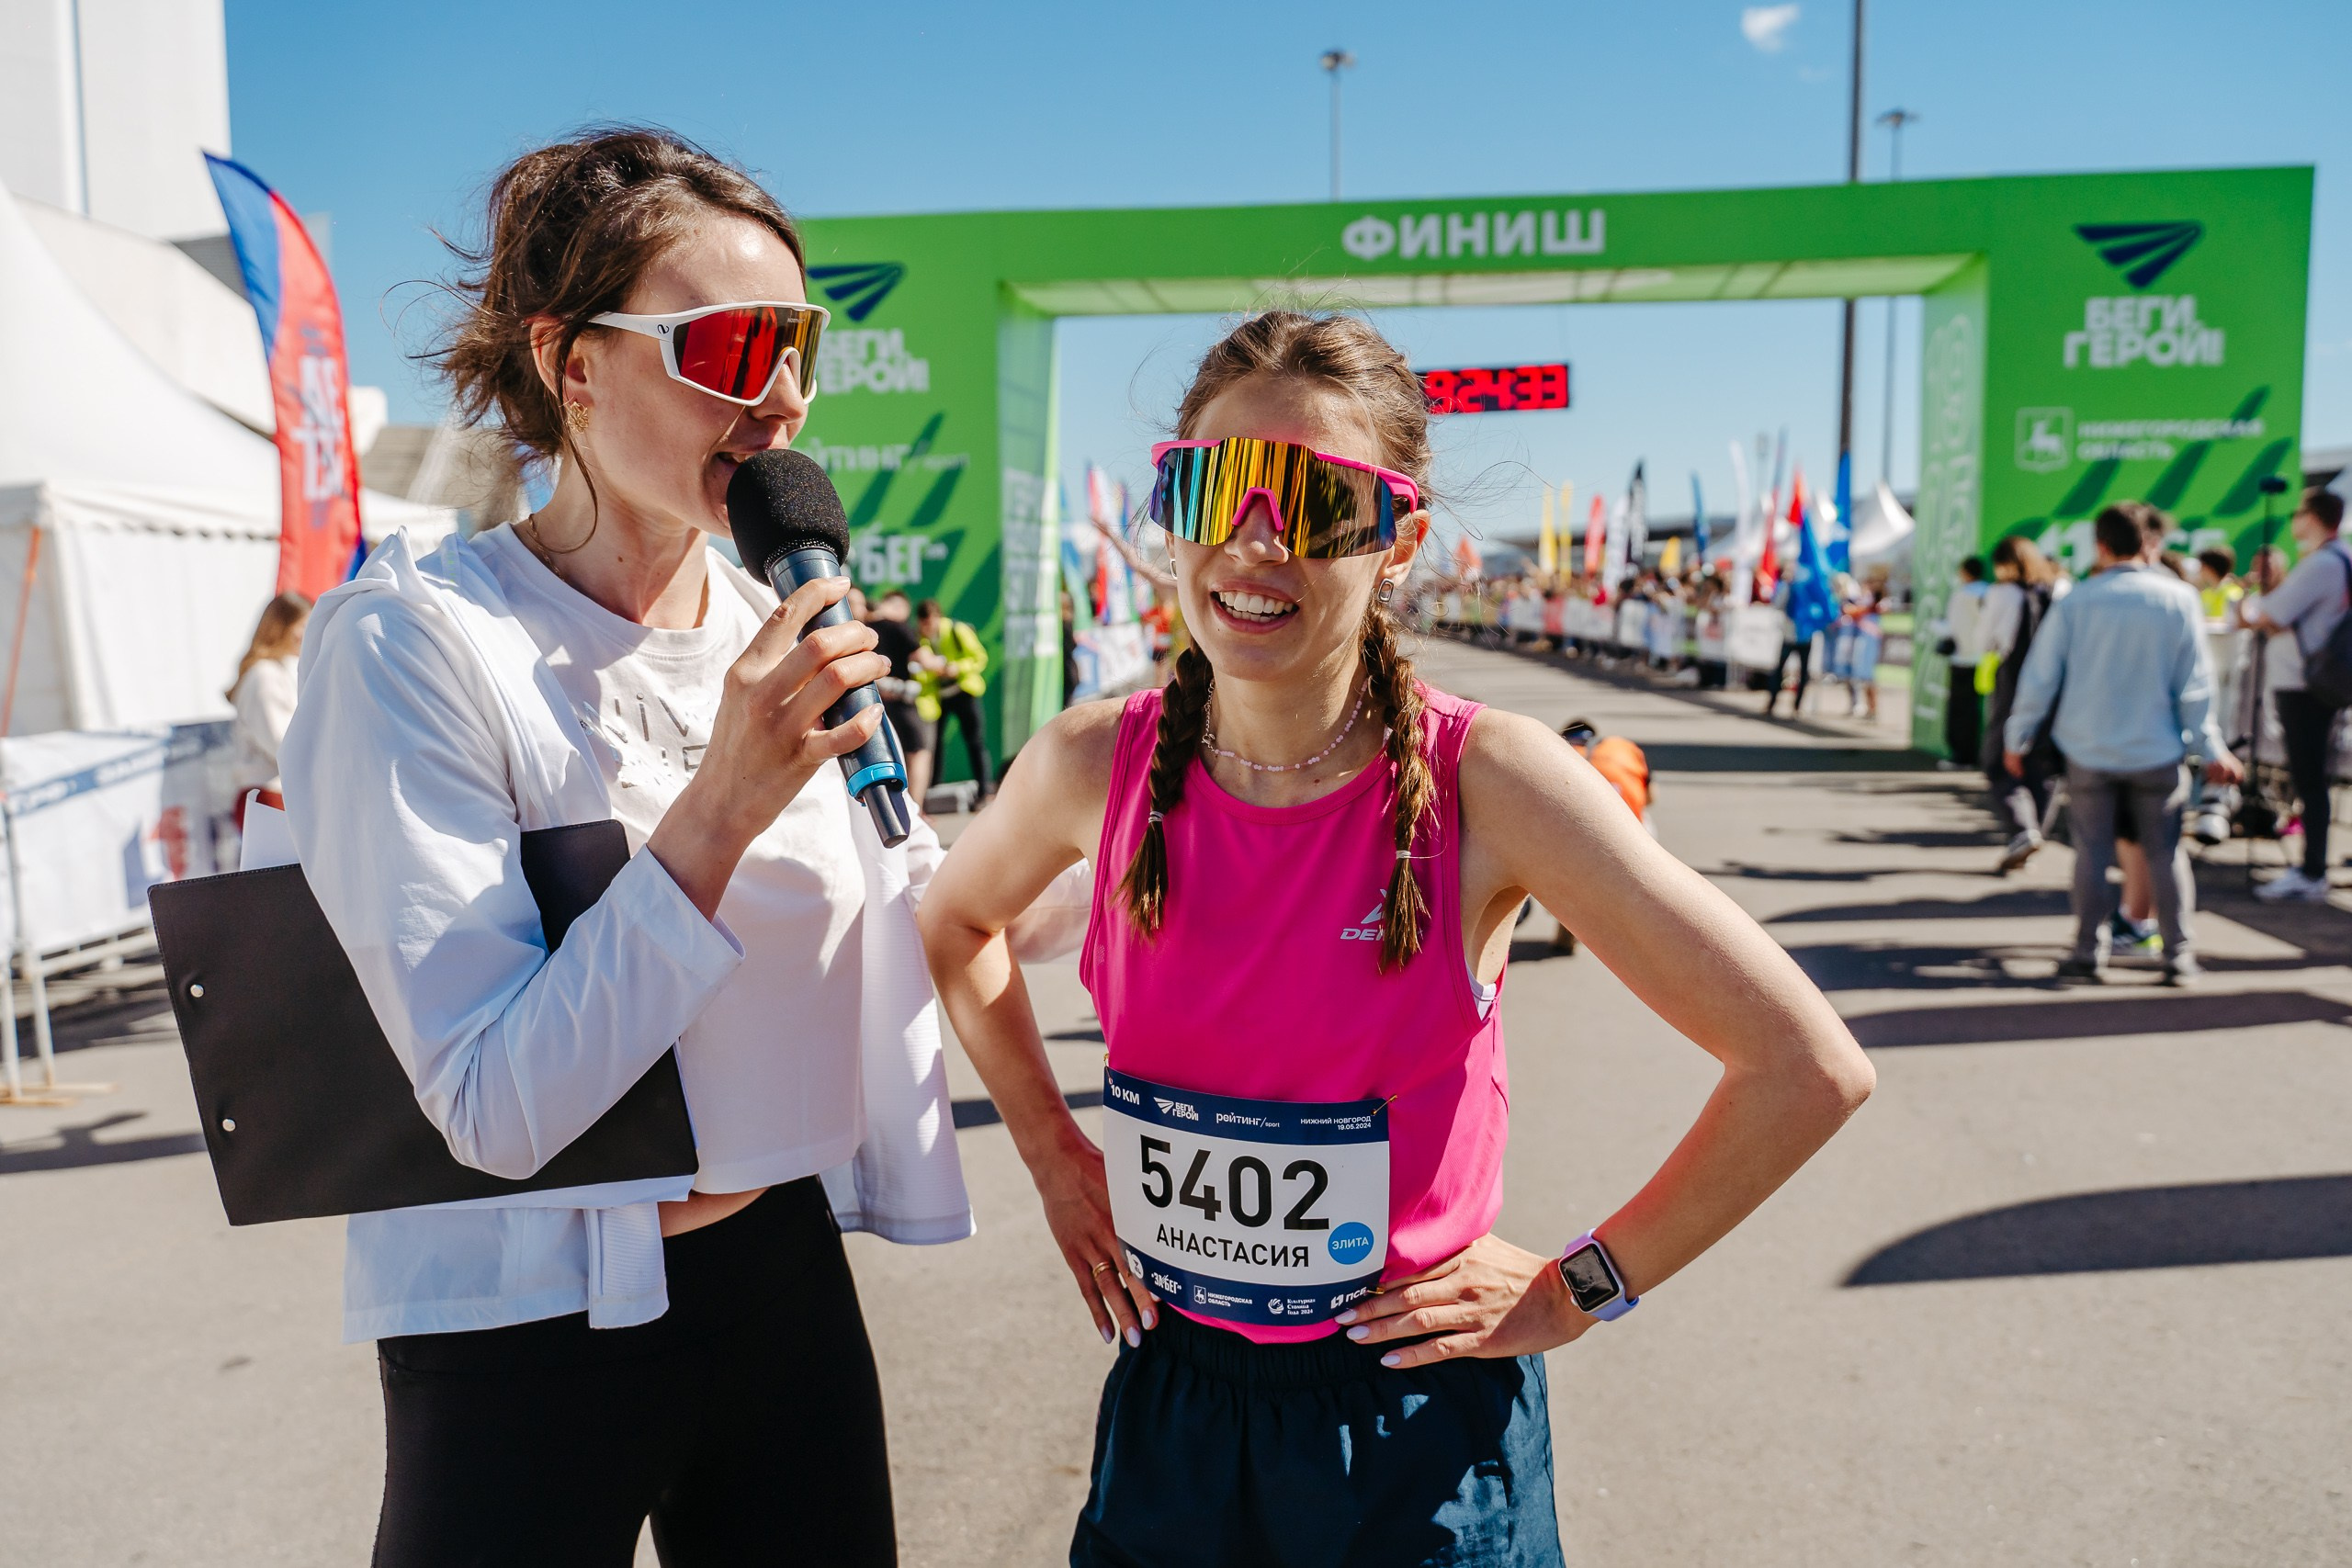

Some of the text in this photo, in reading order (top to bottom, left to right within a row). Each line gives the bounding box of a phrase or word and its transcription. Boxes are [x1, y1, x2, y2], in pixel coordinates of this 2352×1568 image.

[1341, 209, 1606, 261] ФИНИШ
[2064, 327, 2224, 367] ГЕРОЙ!
[1111, 1084, 1140, 1105] 10 КМ
[1172, 1108, 1199, 1122] ГЕРОЙ!
[1300, 1115, 1372, 1125] НИЖНИЙ НОВГОРОД
[1337, 1122, 1372, 1131] 19.05.2024
[1140, 1134, 1329, 1230] 5402
[1156, 1224, 1309, 1268] АНАСТАСИЯ
[1331, 1235, 1370, 1250] ЭЛИТА
[1207, 1292, 1253, 1305] НИЖЕГОРОДСКАЯ
[1345, 1287, 1367, 1302] ПСБ
[1207, 1298, 1231, 1307] ОБЛАСТЬ
